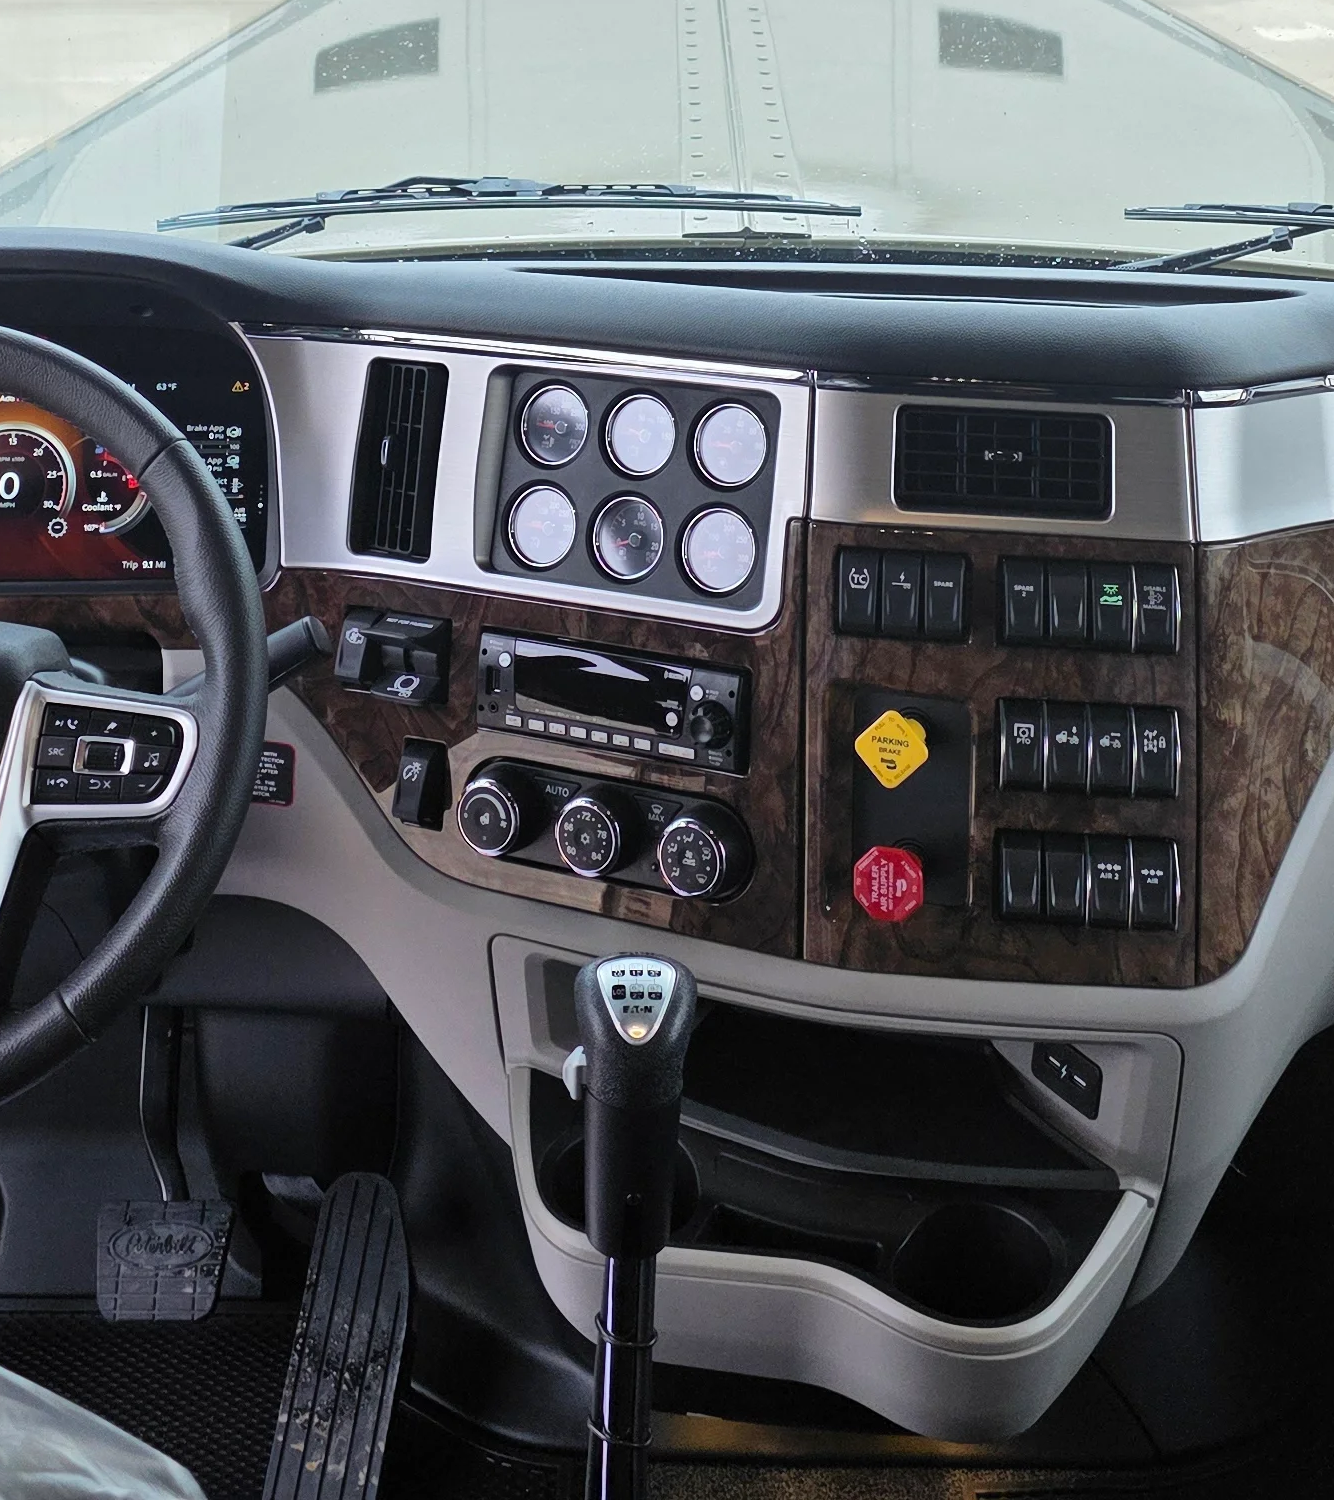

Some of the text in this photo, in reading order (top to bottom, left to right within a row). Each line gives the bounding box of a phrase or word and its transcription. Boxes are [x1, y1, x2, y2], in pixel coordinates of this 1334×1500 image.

[186, 424, 225, 433] Brake App
[9, 437, 18, 445] 15
[33, 448, 44, 457] 20
[207, 457, 223, 466] App
[46, 471, 57, 479] 25
[43, 501, 54, 509] 30
[82, 503, 114, 512] Coolant
[636, 512, 645, 521] 10
[621, 519, 627, 527] 5
[650, 521, 659, 531] 15
[650, 542, 660, 551] 20
[122, 561, 138, 570] Trip
[142, 561, 153, 569] 9.1
[852, 573, 867, 585] TC
[933, 580, 954, 588] SPARE
[1143, 585, 1167, 593] DISABLE
[871, 735, 910, 748] PARKING
[47, 746, 66, 757] SRC
[878, 746, 902, 756] BRAKE
[545, 784, 570, 798] AUTO
[581, 811, 591, 822] 72
[648, 812, 665, 823] MAX
[590, 850, 602, 861] 84
[1099, 872, 1120, 881] AIR 2
[1147, 877, 1159, 885] AIR
[871, 864, 879, 903] TRAILER
[880, 858, 888, 912] AIR SUPPLY
[124, 1234, 204, 1257] Peterbilt
